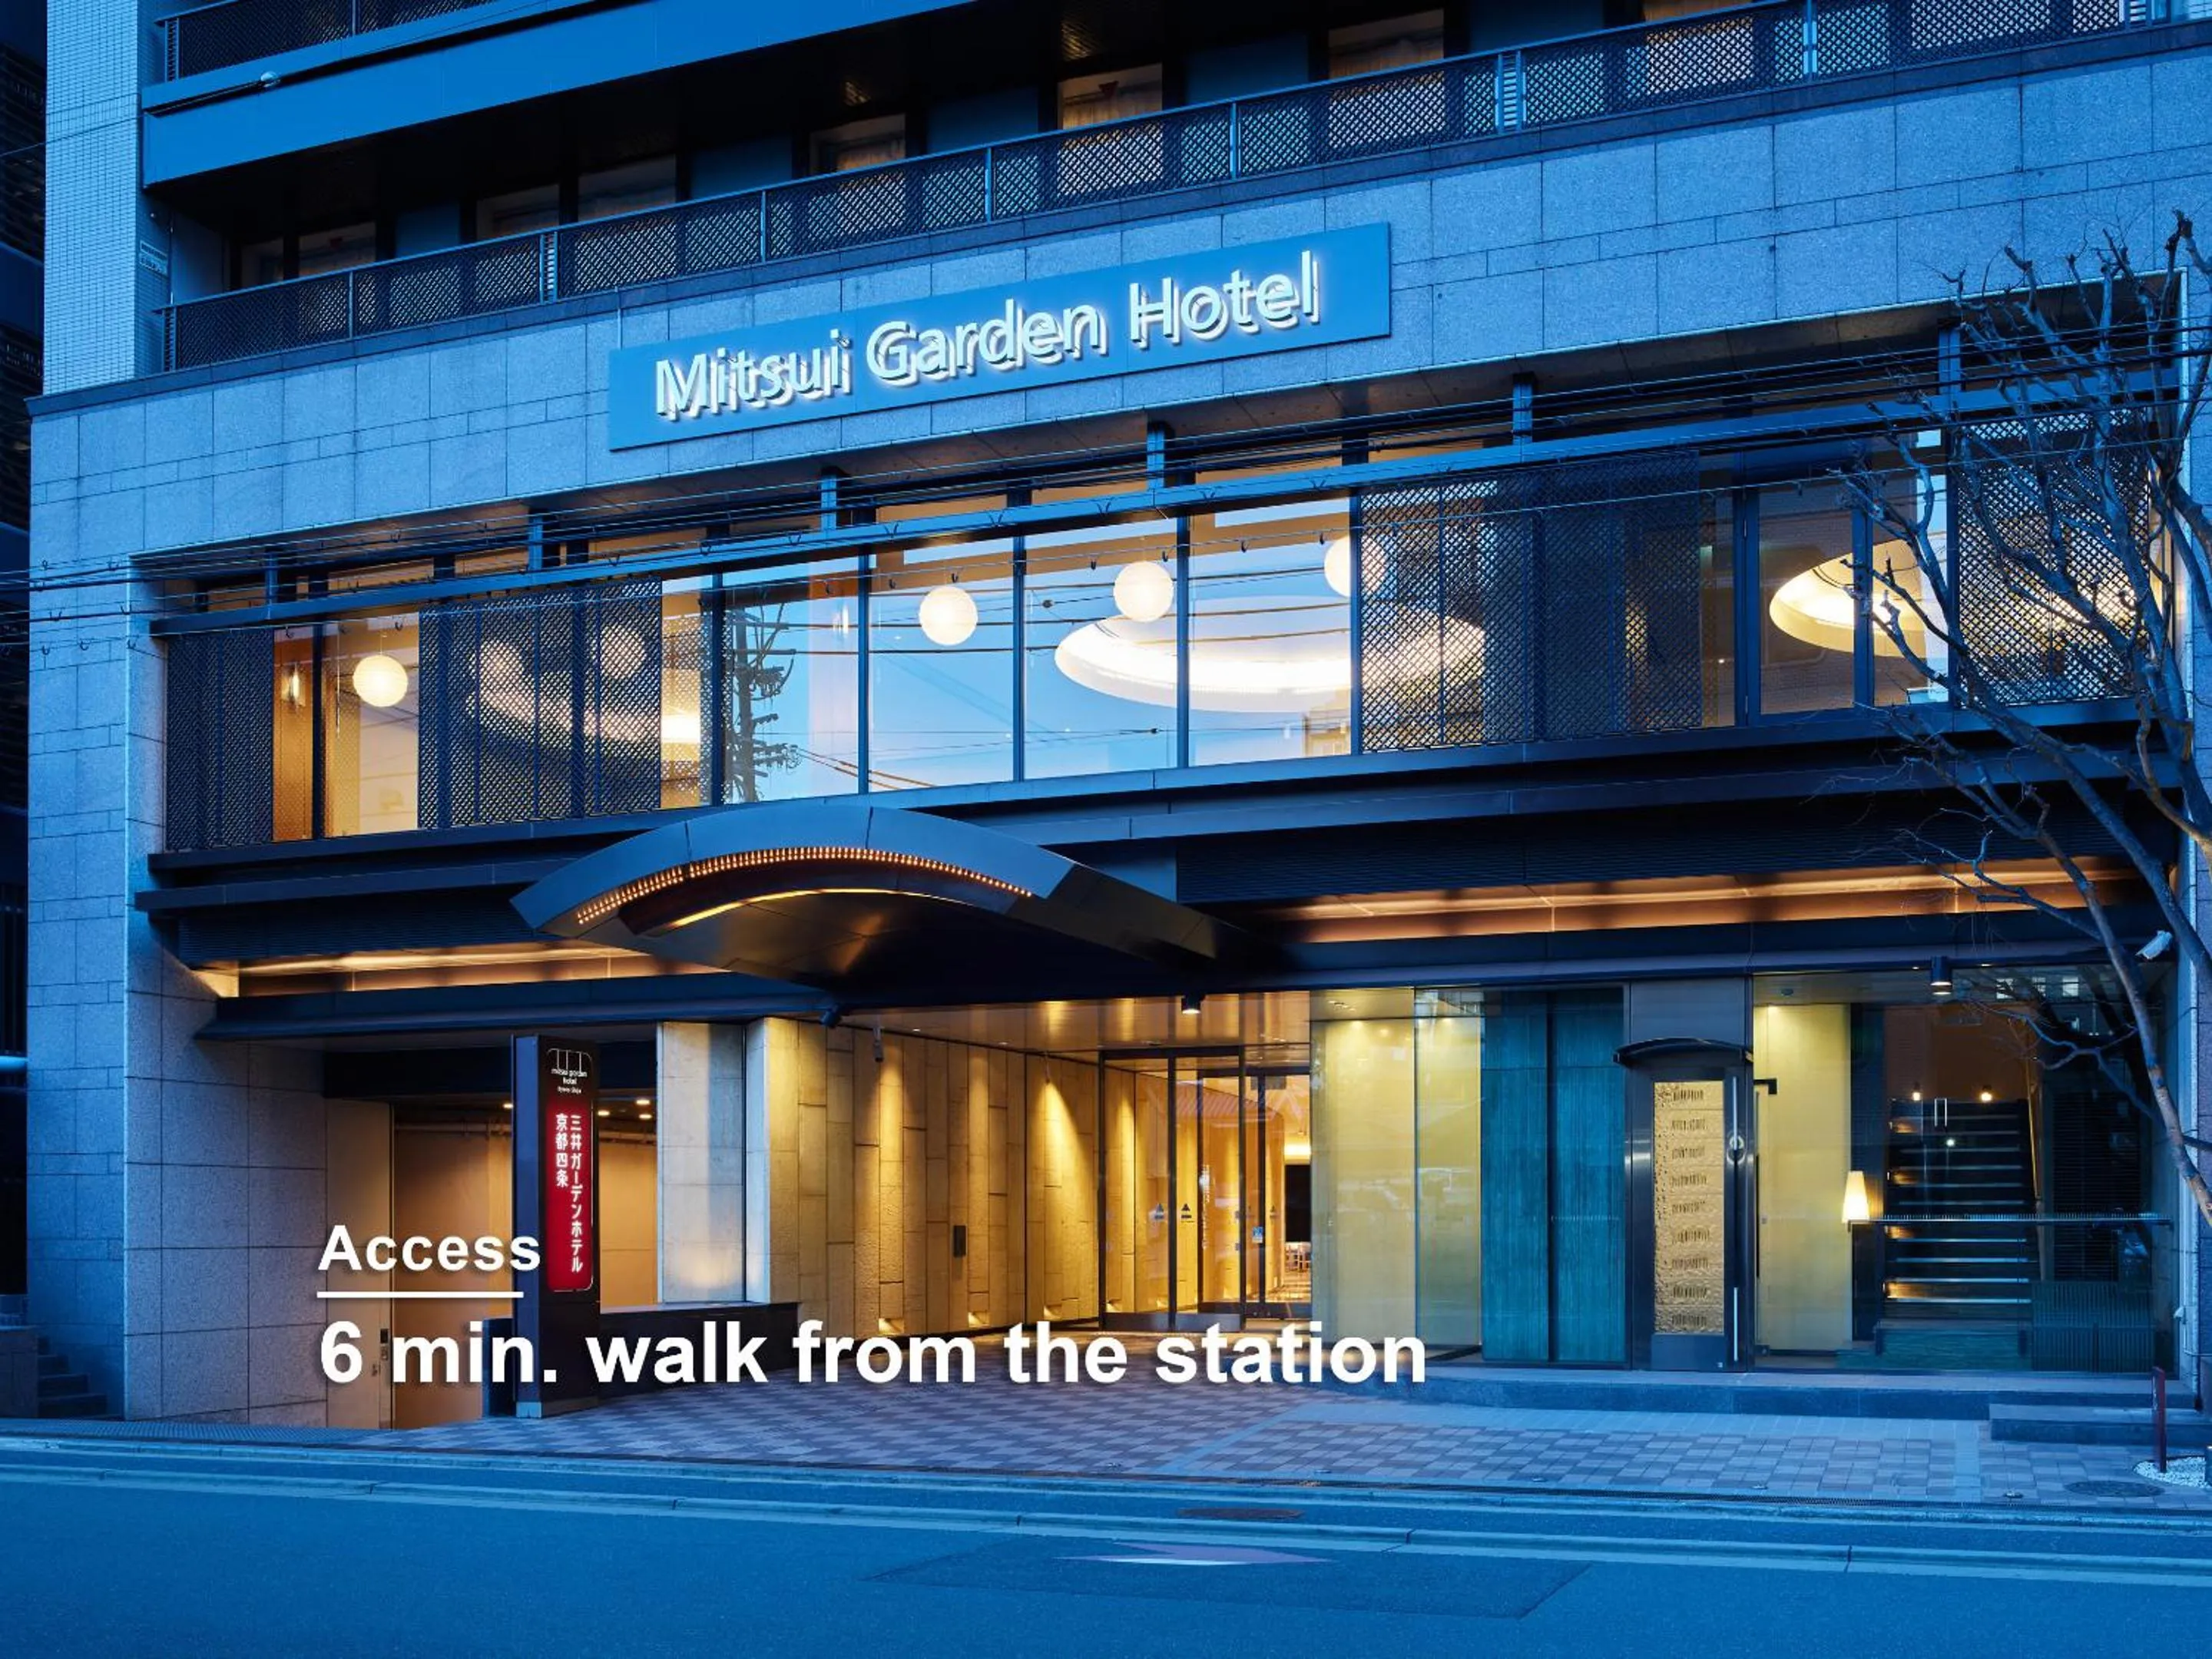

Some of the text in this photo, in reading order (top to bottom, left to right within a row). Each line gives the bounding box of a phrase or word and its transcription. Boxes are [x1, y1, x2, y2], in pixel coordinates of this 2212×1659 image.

[655, 250, 1318, 420] Mitsui Garden Hotel
[555, 1112, 569, 1188] 京都四条
[570, 1114, 584, 1273] 三井ガーデンホテル
